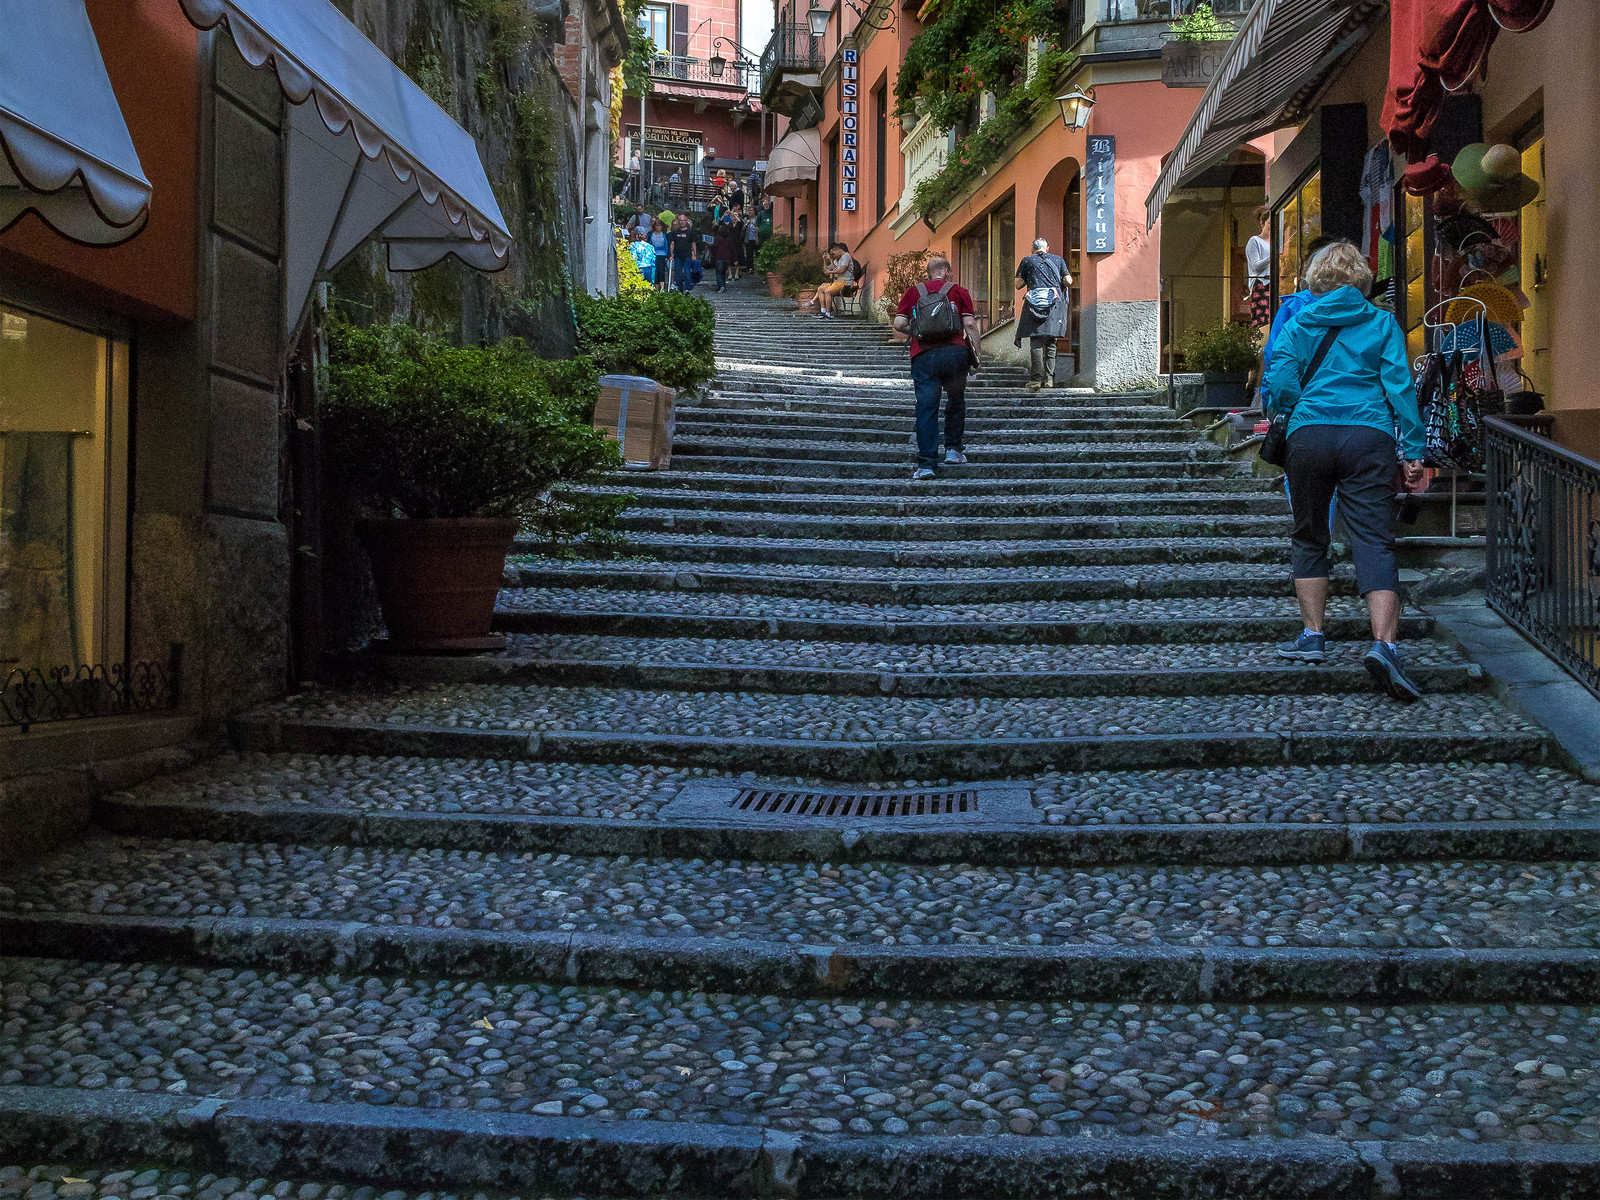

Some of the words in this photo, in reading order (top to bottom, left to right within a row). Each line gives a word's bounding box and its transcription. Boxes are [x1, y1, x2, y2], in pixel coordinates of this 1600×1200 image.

[672, 135, 701, 144] LEGNO
[844, 50, 856, 210] RISTORANTE
[1091, 139, 1111, 249] Bilacus
